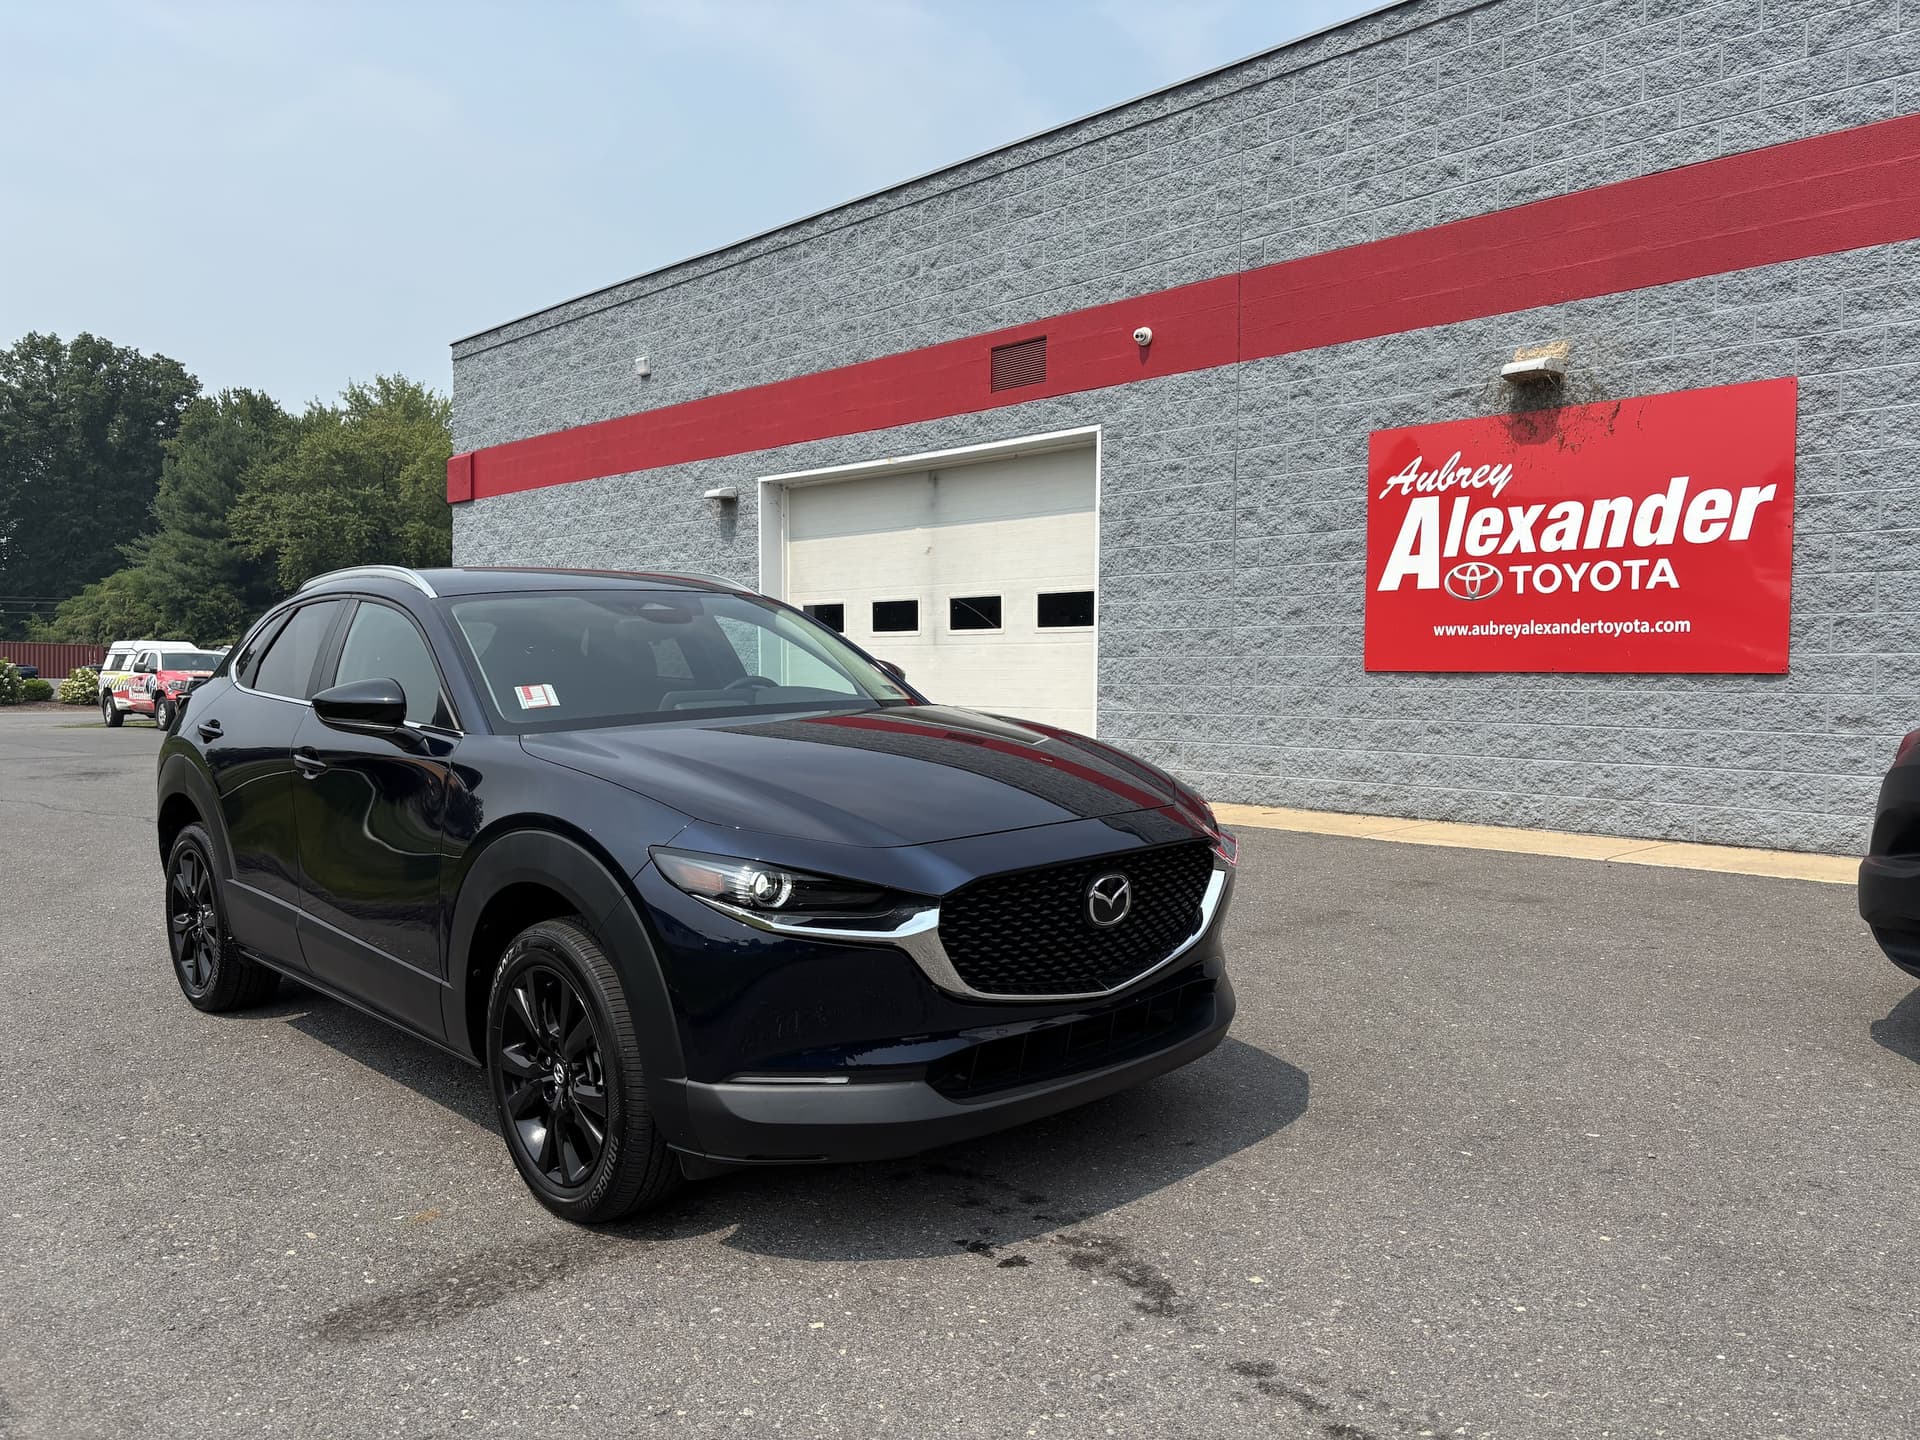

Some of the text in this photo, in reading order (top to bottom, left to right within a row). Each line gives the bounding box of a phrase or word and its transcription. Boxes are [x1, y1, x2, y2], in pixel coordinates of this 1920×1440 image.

[1378, 450, 1513, 500] Aubrey
[1377, 476, 1777, 592] Alexander
[1508, 558, 1680, 595] TOYOTA
[1433, 618, 1691, 640] www.aubreyalexandertoyota.com
